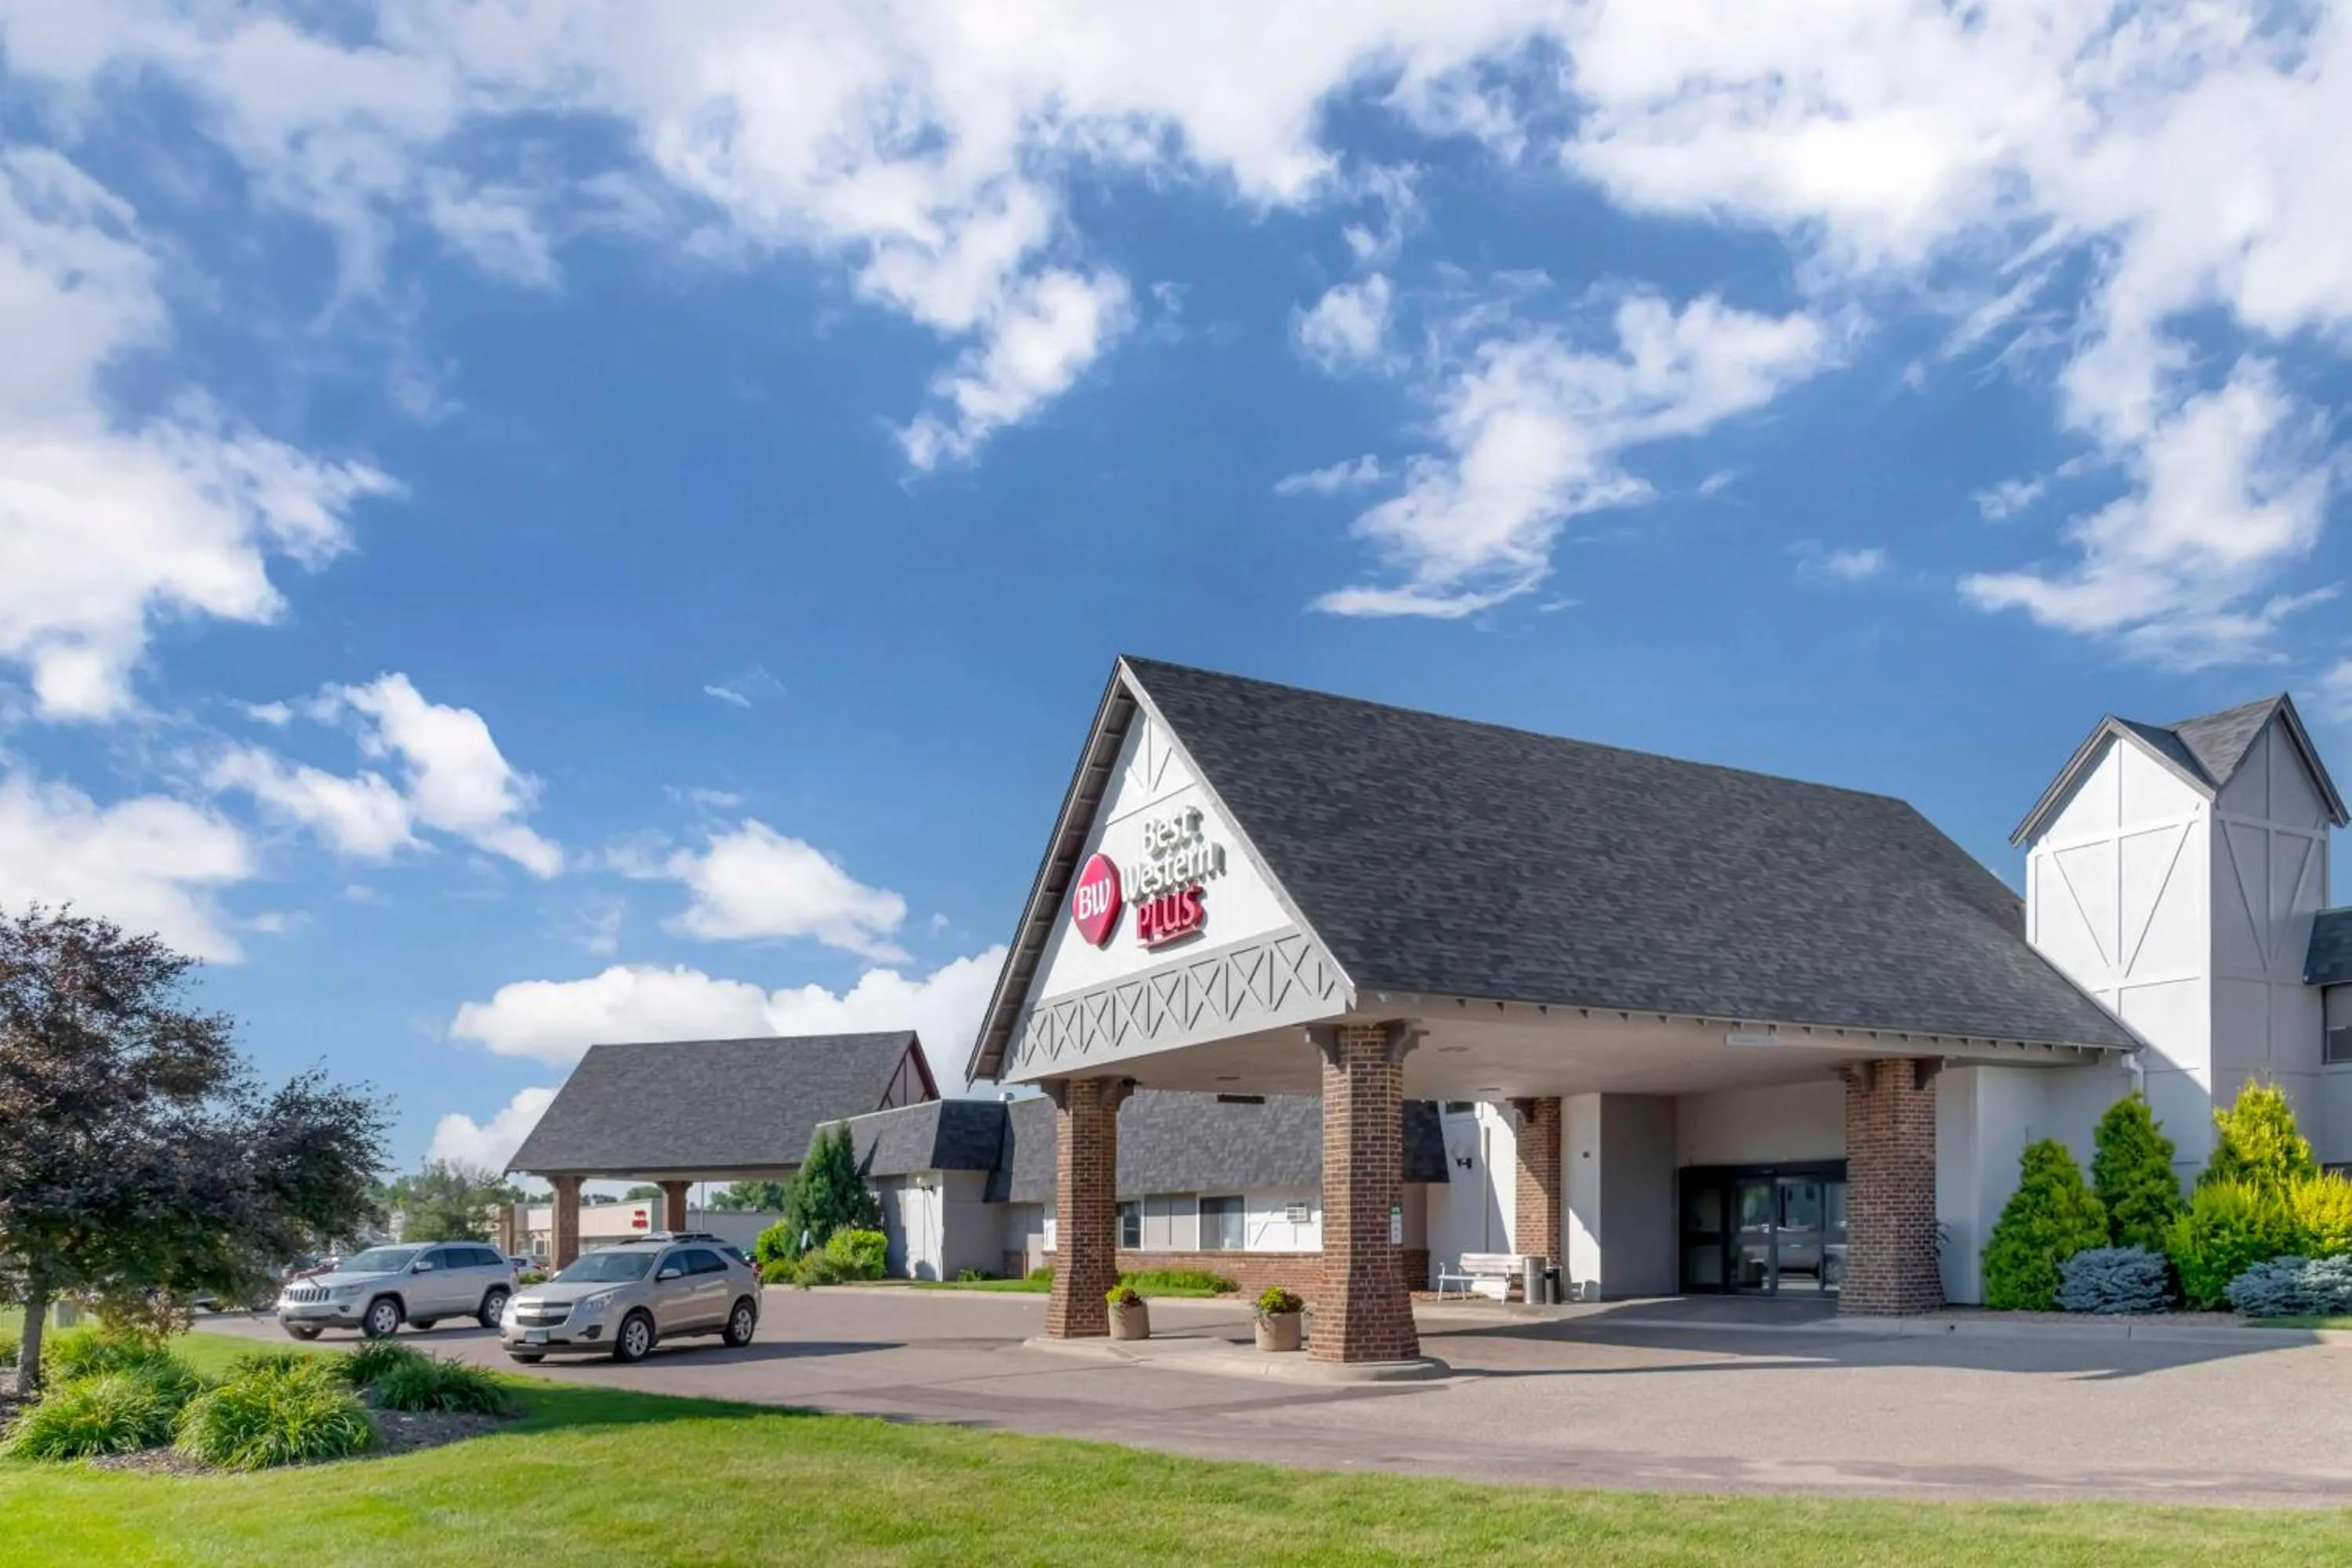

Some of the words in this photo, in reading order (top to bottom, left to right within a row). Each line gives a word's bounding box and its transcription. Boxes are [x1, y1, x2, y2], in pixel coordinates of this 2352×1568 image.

[1142, 805, 1198, 855] Best
[1120, 840, 1218, 903] Western
[1078, 877, 1111, 920] BW
